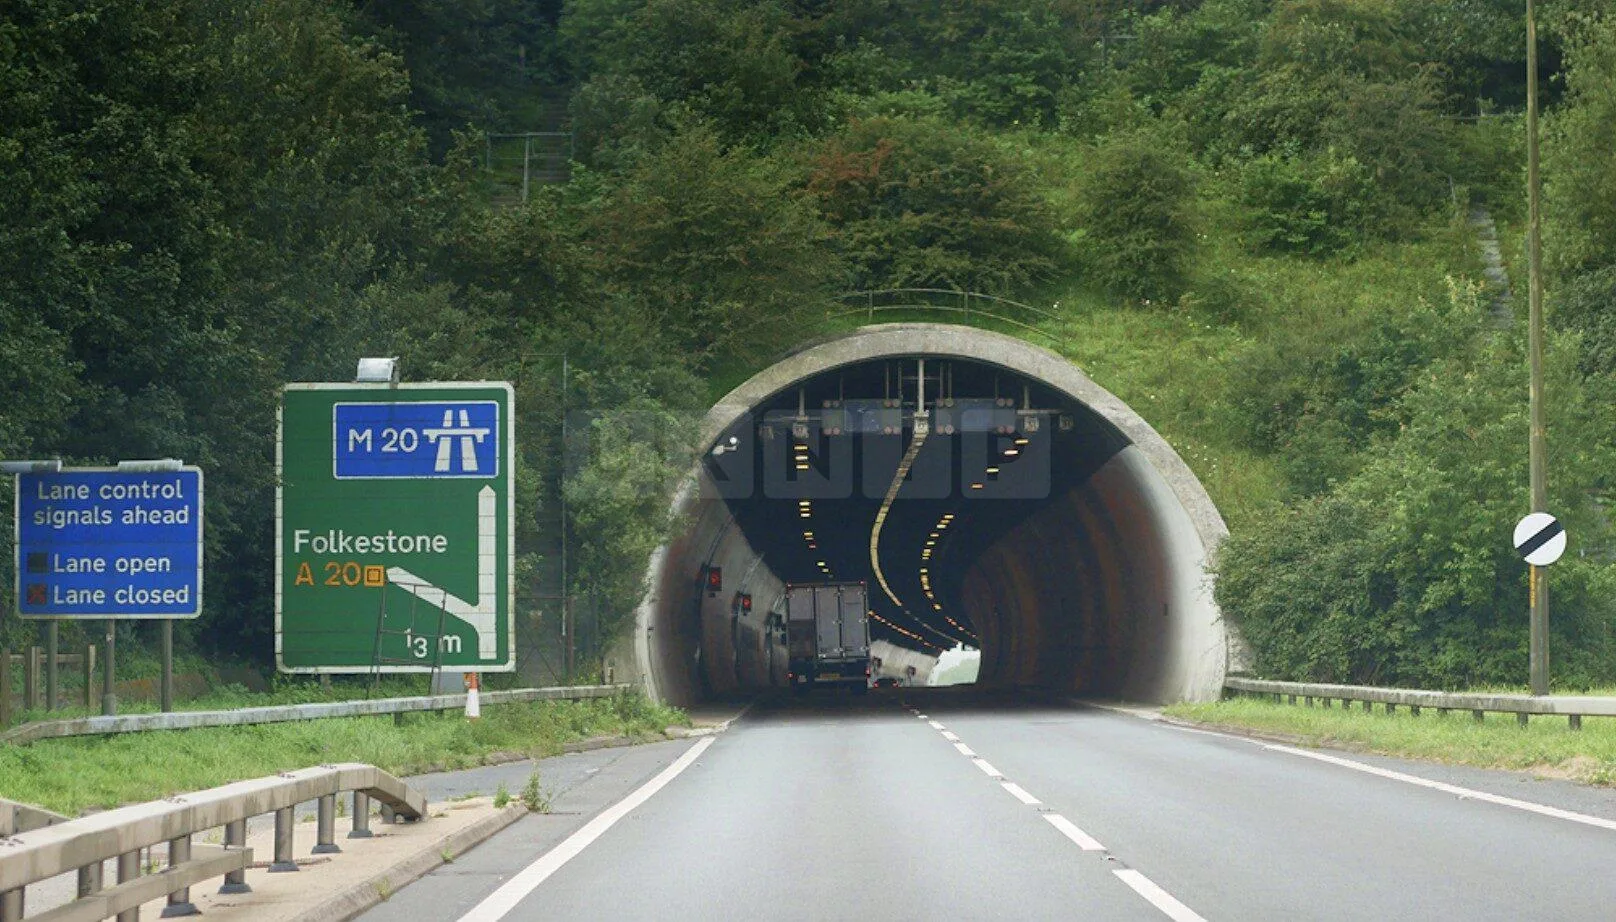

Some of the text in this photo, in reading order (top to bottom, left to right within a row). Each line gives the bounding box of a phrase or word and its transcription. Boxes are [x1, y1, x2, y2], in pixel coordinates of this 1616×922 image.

[348, 427, 419, 453] M 20
[38, 478, 184, 500] Lane control
[34, 504, 190, 529] signals ahead
[294, 529, 448, 554] Folkestone
[54, 553, 171, 576] Lane open
[294, 561, 362, 587] A 20
[54, 584, 189, 605] Lane closed
[438, 634, 462, 654] m
